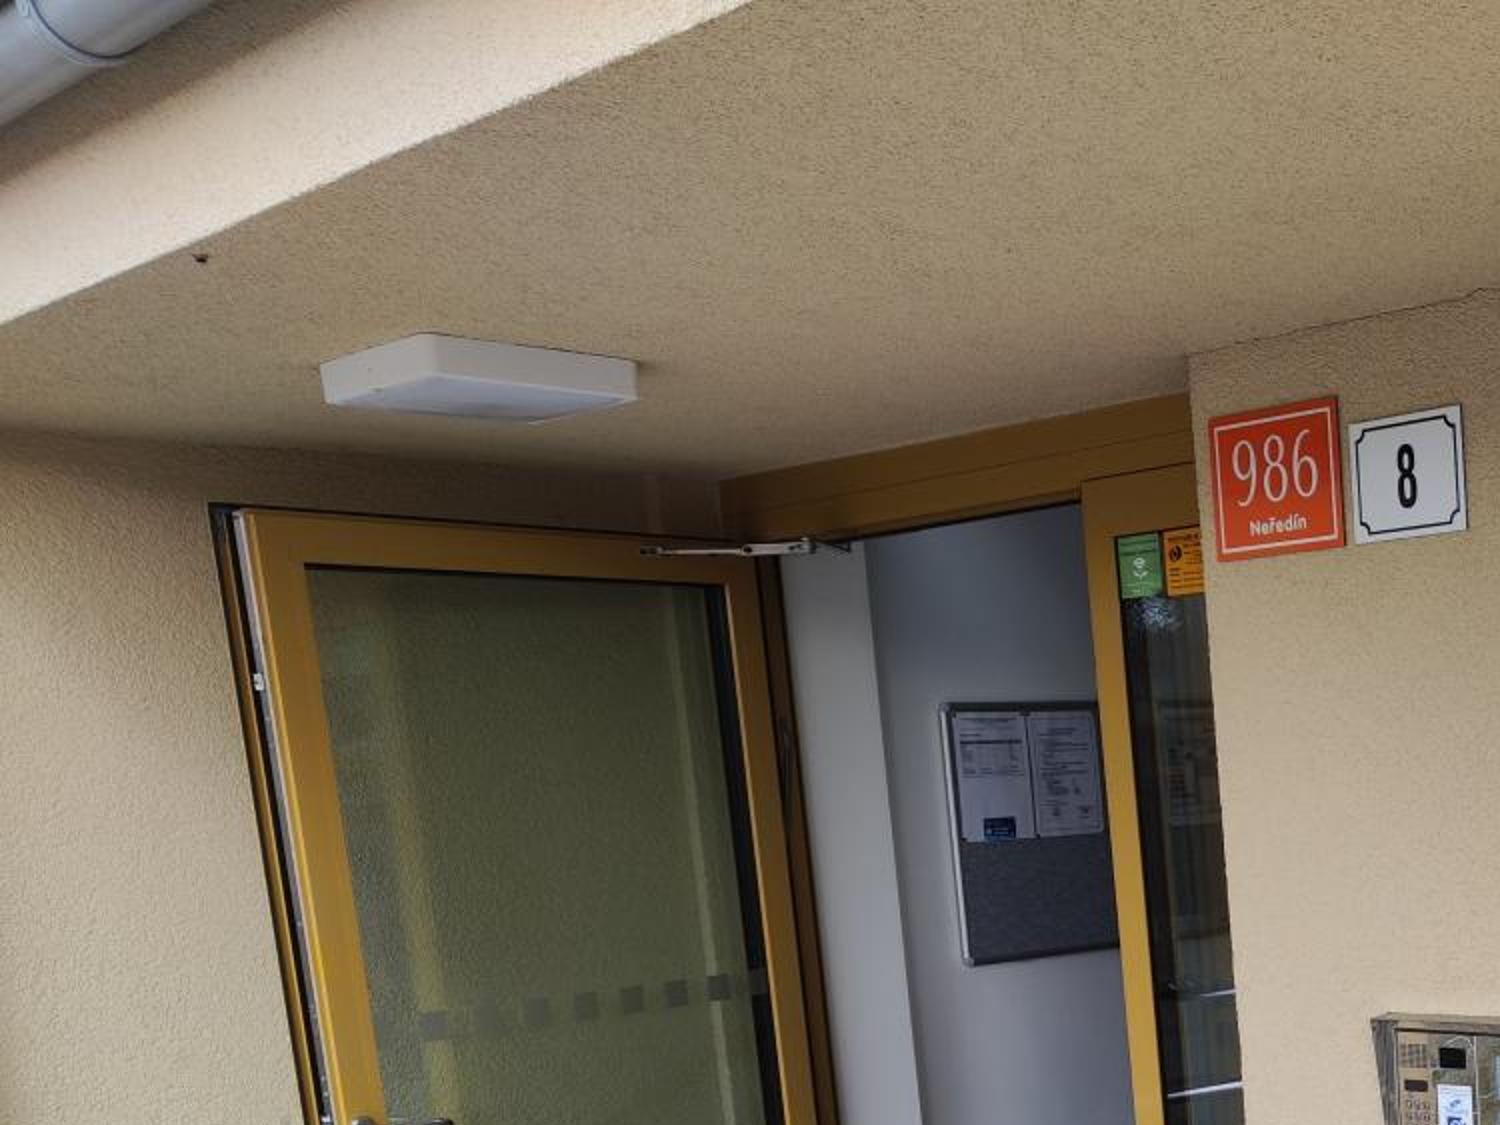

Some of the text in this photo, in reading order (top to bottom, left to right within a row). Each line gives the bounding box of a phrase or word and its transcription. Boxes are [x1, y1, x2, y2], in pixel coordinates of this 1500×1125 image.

[1231, 429, 1319, 507] 986
[1397, 443, 1418, 509] 8
[1249, 513, 1307, 537] Neředín
